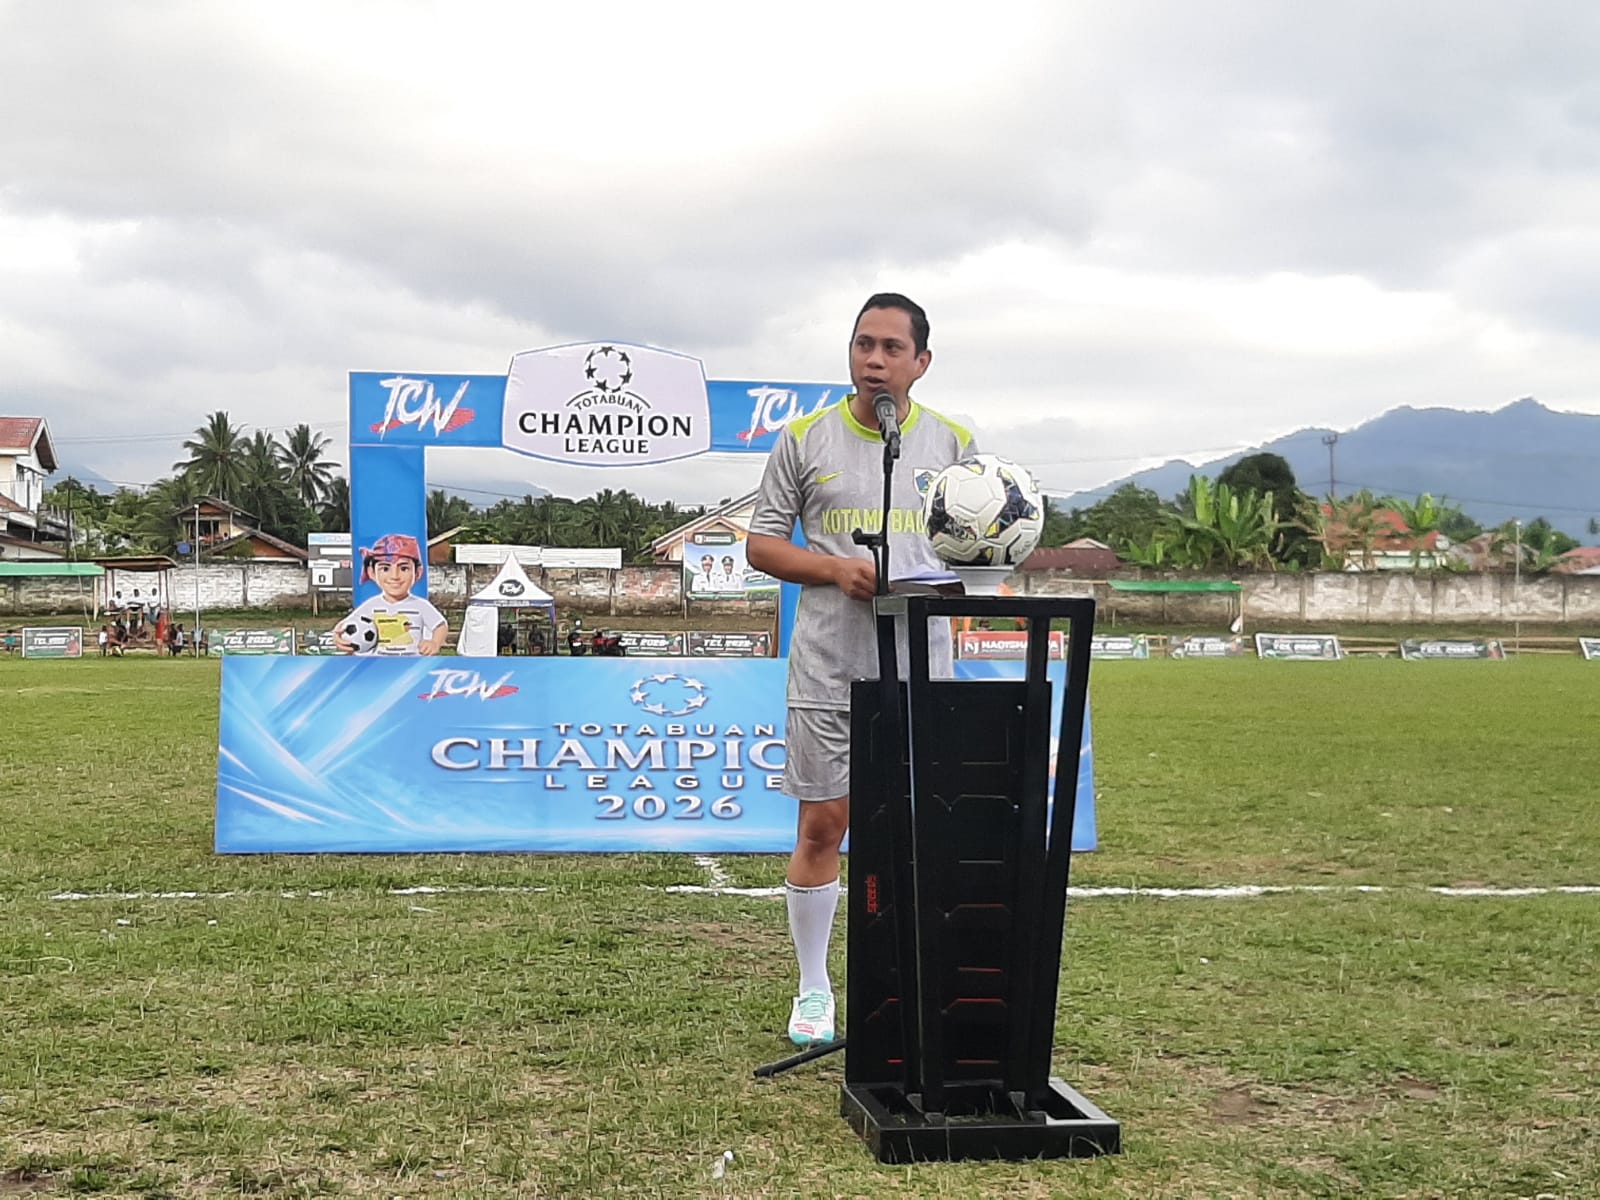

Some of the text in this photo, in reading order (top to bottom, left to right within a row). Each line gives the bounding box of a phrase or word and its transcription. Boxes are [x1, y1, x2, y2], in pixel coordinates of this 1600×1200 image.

[378, 376, 470, 441] TCW
[574, 392, 644, 413] TOTABUAN
[518, 411, 692, 438] CHAMPION
[565, 438, 649, 454] LEAGUE
[428, 669, 515, 703] TCW
[554, 723, 774, 737] TOTABUAN
[431, 738, 786, 771] CHAMPIO
[545, 774, 783, 790] LEAGUE
[595, 795, 742, 820] 2026
